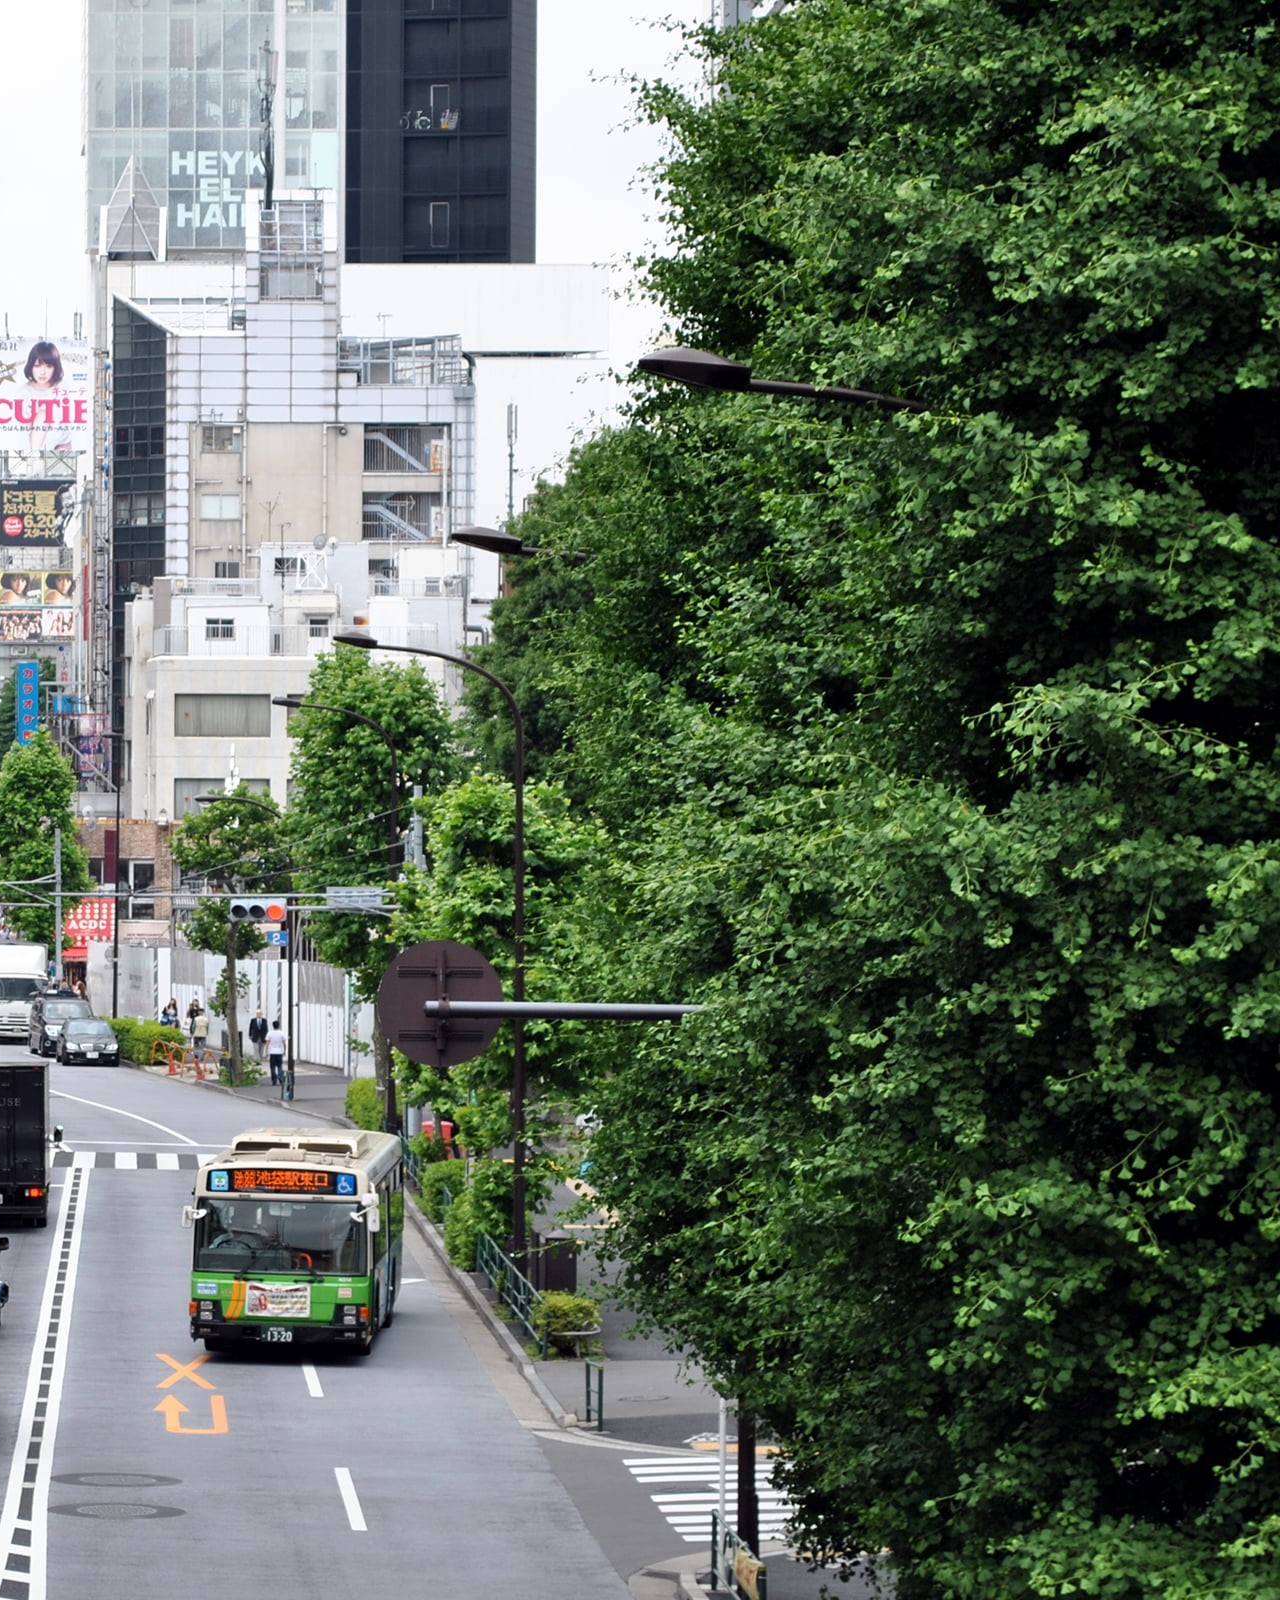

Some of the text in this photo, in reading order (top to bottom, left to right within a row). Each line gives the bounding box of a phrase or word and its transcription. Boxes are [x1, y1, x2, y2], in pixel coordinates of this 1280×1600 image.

[3, 490, 34, 503] ドコモ
[34, 490, 57, 514] 夏
[3, 504, 34, 514] だけの
[23, 515, 56, 528] 6.20
[68, 920, 108, 930] ACDC
[256, 1170, 329, 1187] 池袋駅東口
